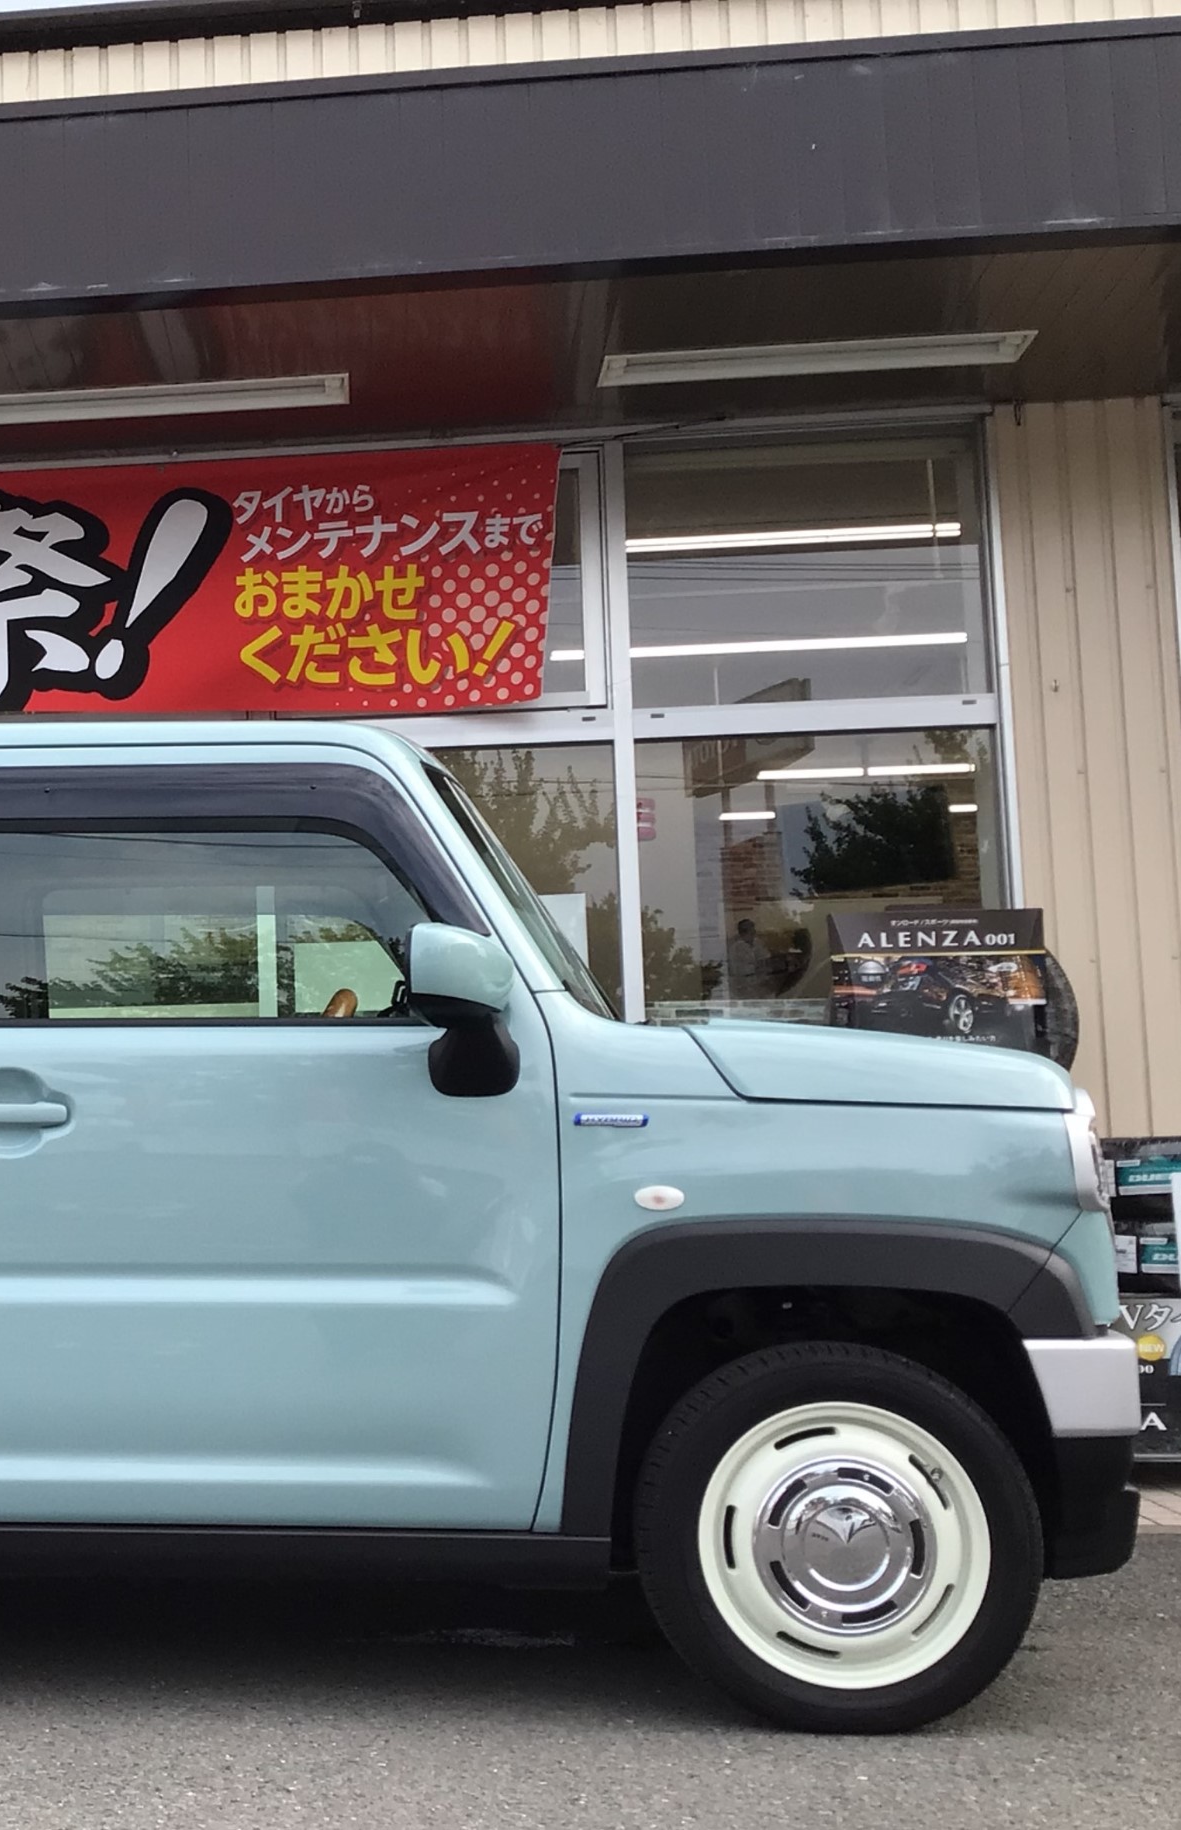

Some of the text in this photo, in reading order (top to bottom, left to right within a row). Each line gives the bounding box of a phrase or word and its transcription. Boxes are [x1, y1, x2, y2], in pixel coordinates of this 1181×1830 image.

[232, 485, 376, 525] タイヤから
[240, 511, 544, 563] メンテナンスまで
[234, 563, 426, 621] おまかせ
[239, 619, 516, 686] ください!
[857, 930, 1016, 948] ALENZA 001
[1128, 1173, 1172, 1182] DUE
[1118, 1303, 1181, 1332] Vタ
